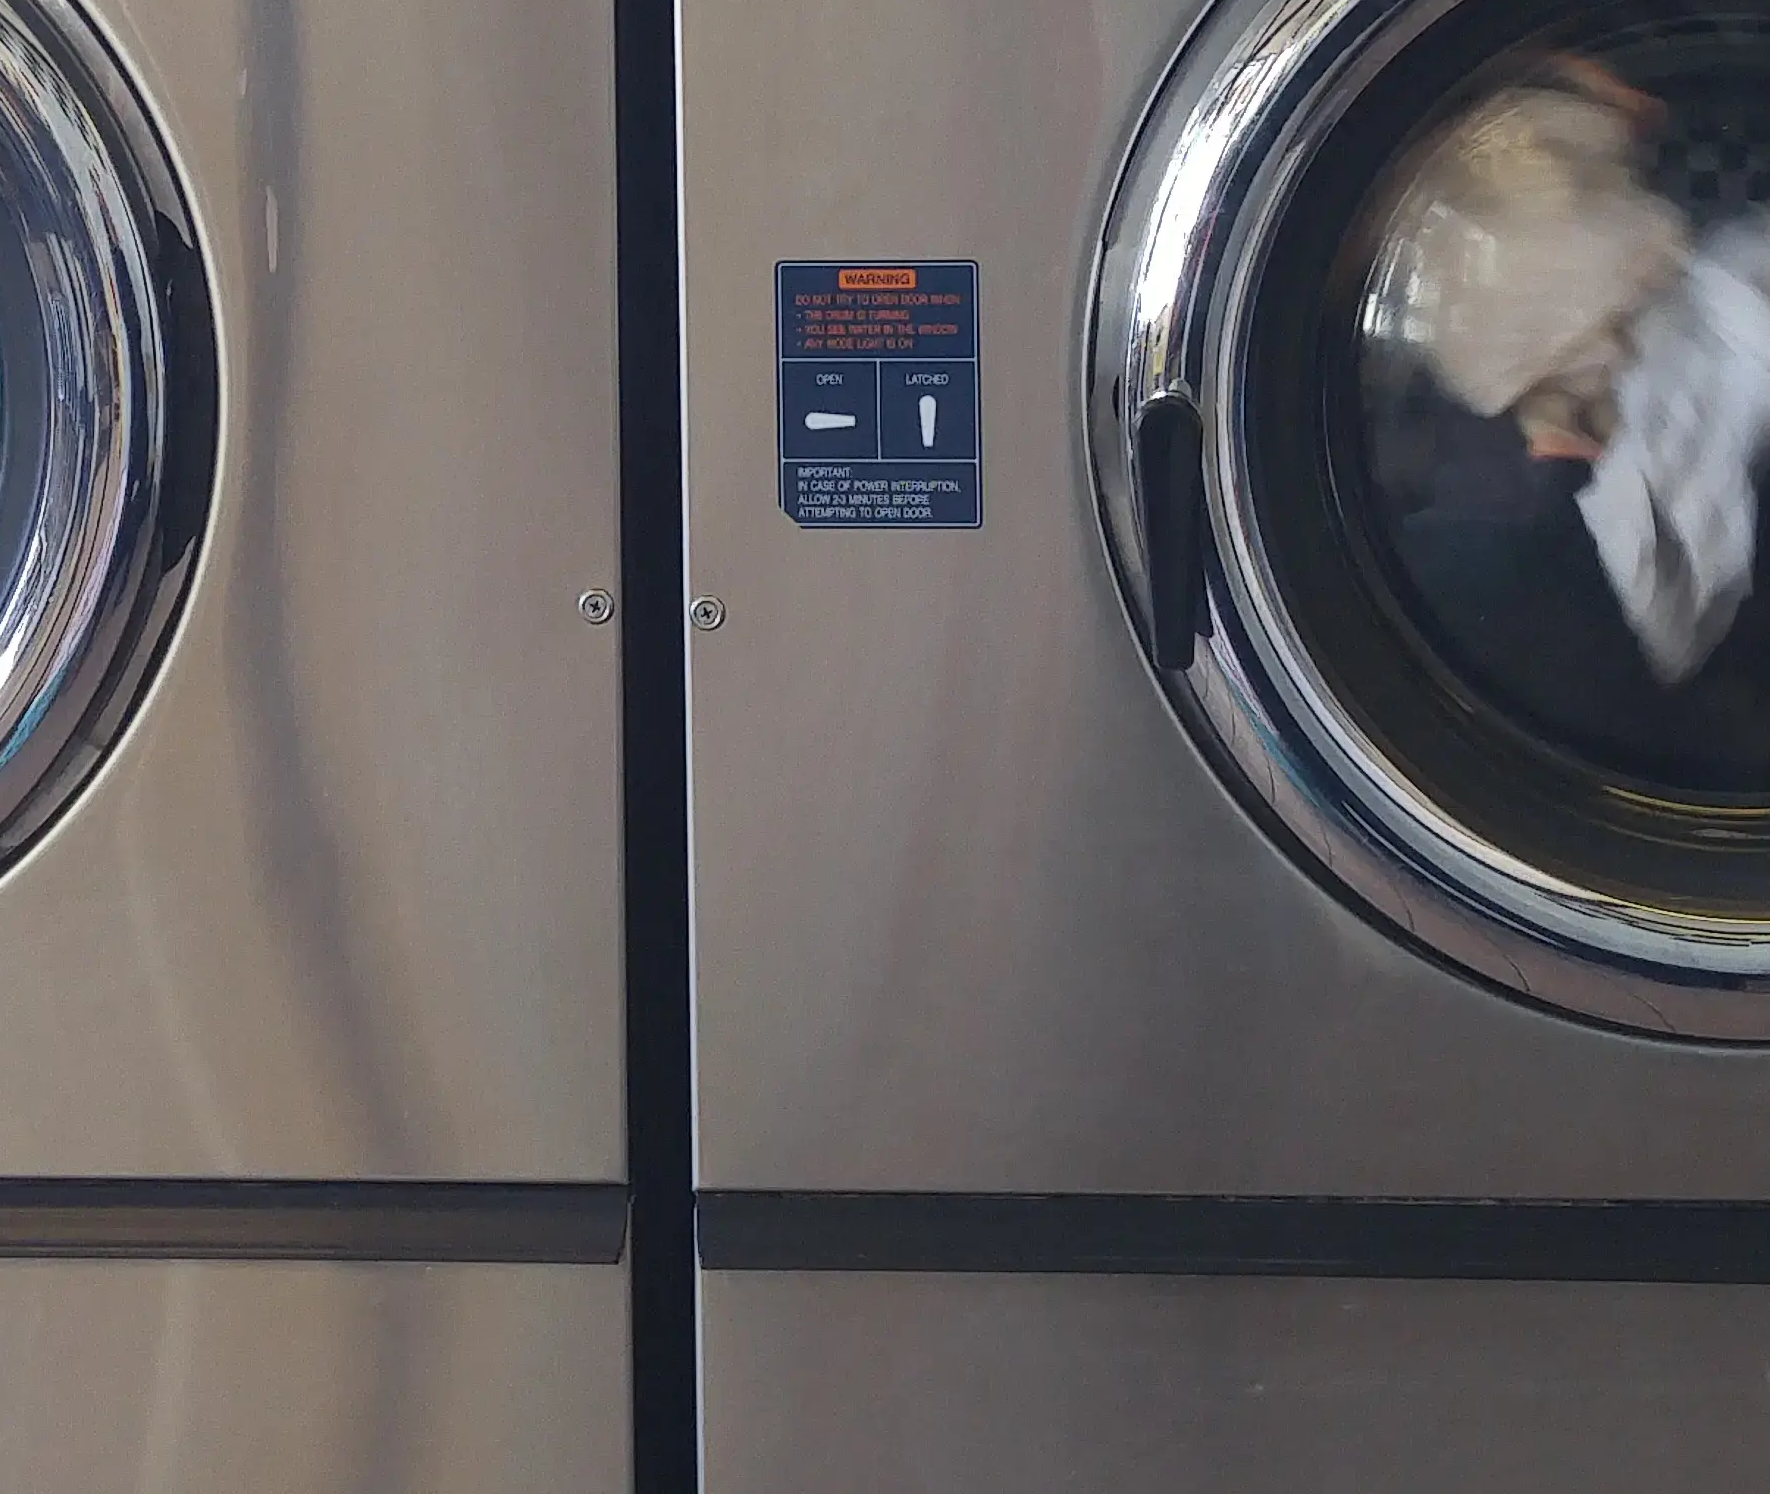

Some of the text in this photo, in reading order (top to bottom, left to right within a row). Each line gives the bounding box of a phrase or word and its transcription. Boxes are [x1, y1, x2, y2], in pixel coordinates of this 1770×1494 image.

[844, 272, 910, 286] WARNING
[816, 373, 843, 386] OPEN
[905, 373, 949, 386] LATCHED
[797, 480, 808, 492] IN
[810, 480, 836, 492] CASE
[837, 480, 850, 492] OF
[854, 480, 888, 492] POWER
[797, 494, 830, 505] ALLOW
[848, 494, 890, 505] MINUTES
[798, 506, 900, 518] ATTEMPTING TO OPEN
